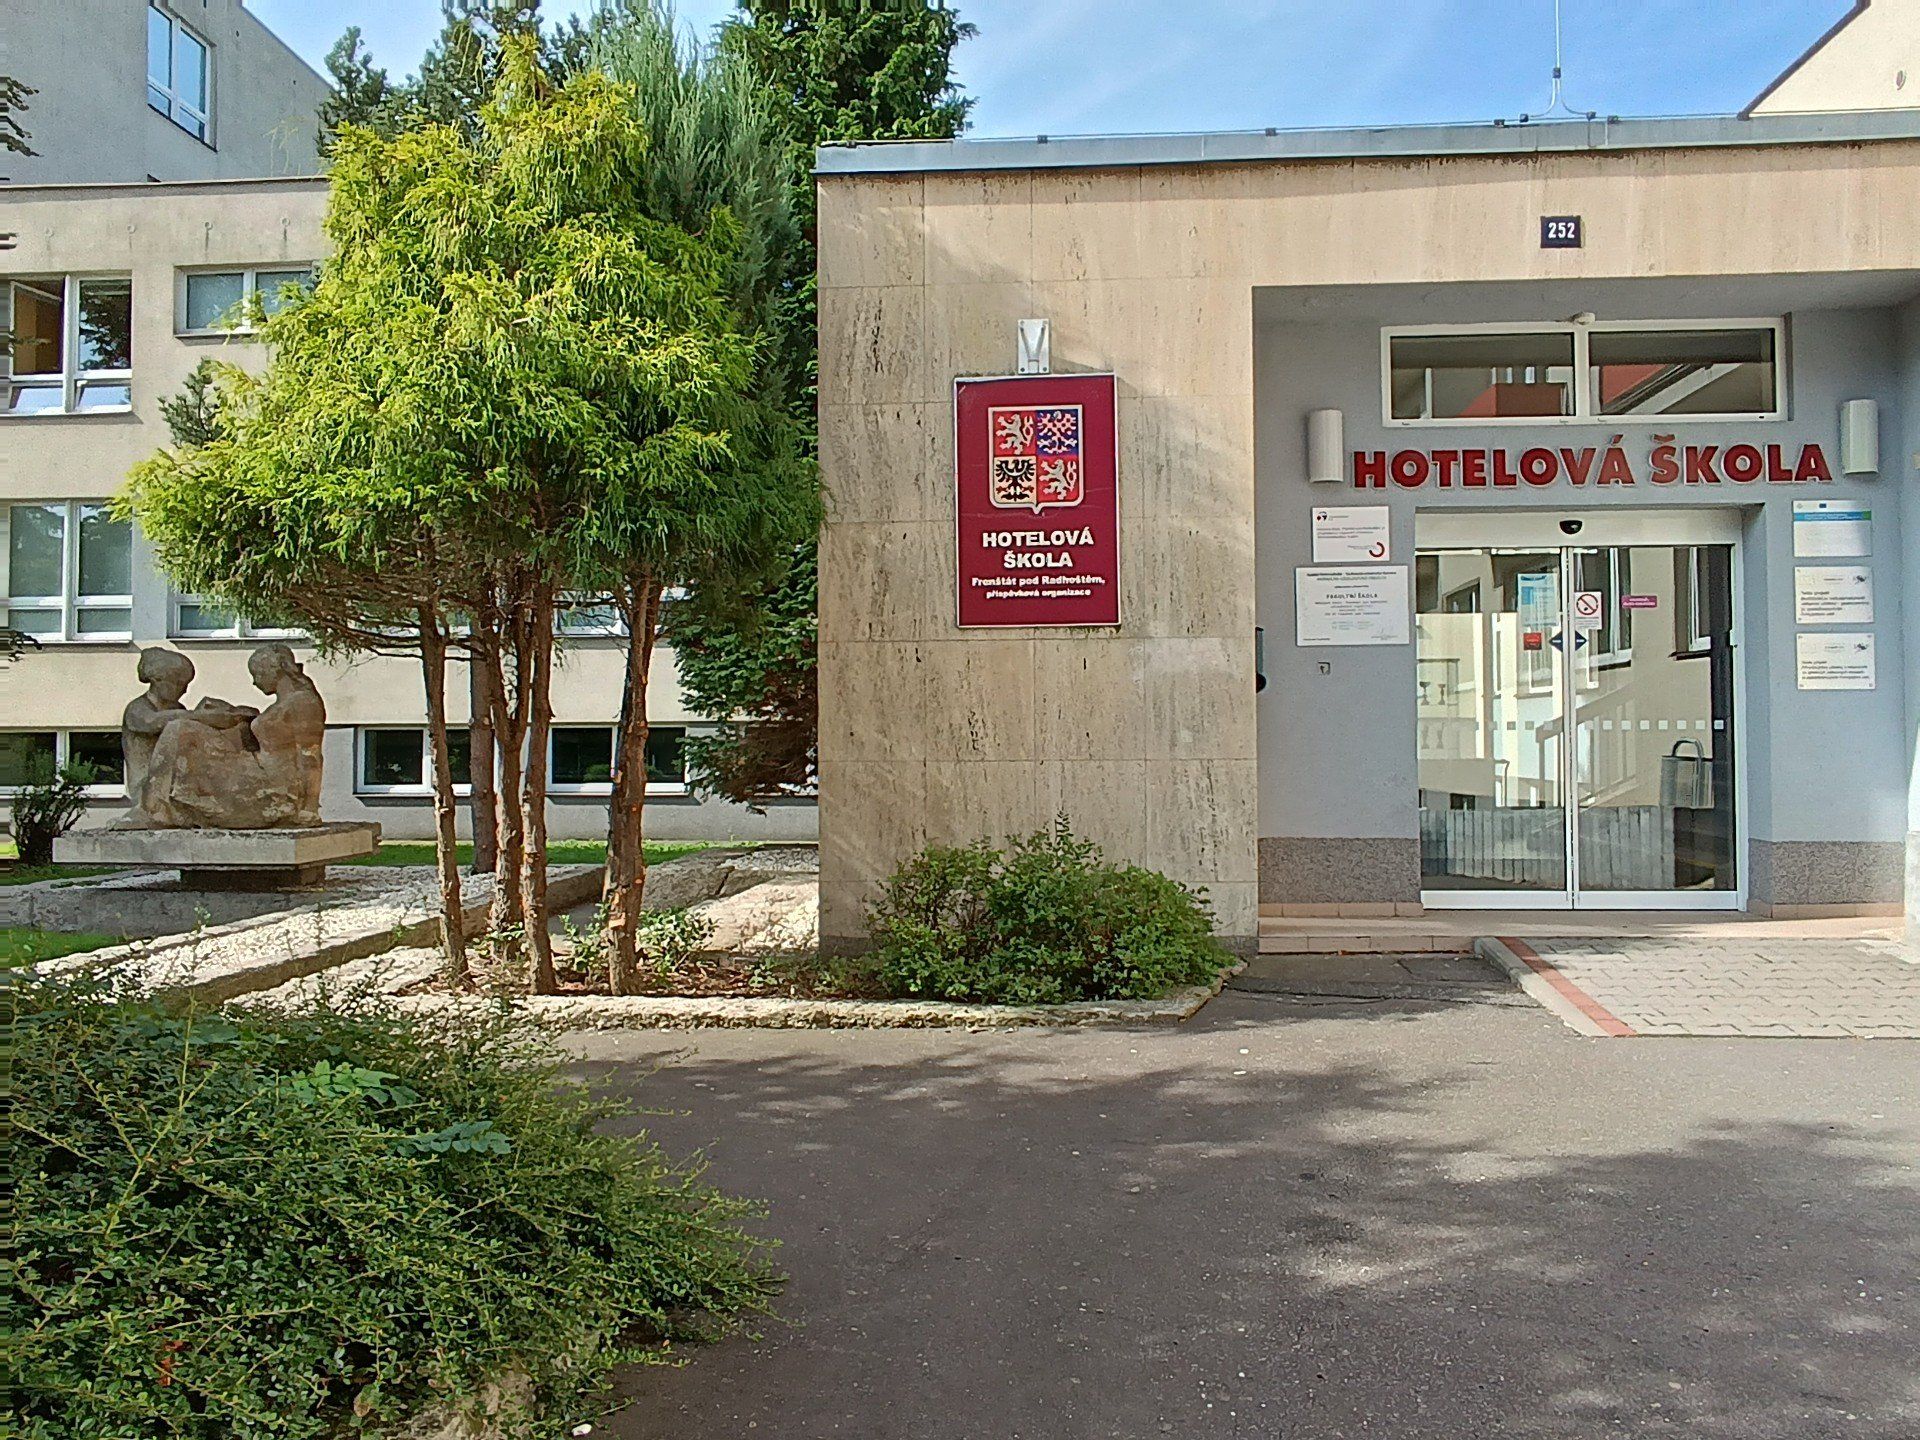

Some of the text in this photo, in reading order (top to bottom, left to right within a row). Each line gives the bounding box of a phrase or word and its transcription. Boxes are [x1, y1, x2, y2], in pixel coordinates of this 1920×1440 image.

[1548, 222, 1575, 239] 252
[1354, 433, 1834, 489] HOTELOVÁ ŠKOLA
[982, 526, 1094, 547] HOTELOVÁ
[1003, 550, 1073, 568] ŠKOLA
[1019, 575, 1040, 587] pod
[1041, 588, 1092, 598] organizace
